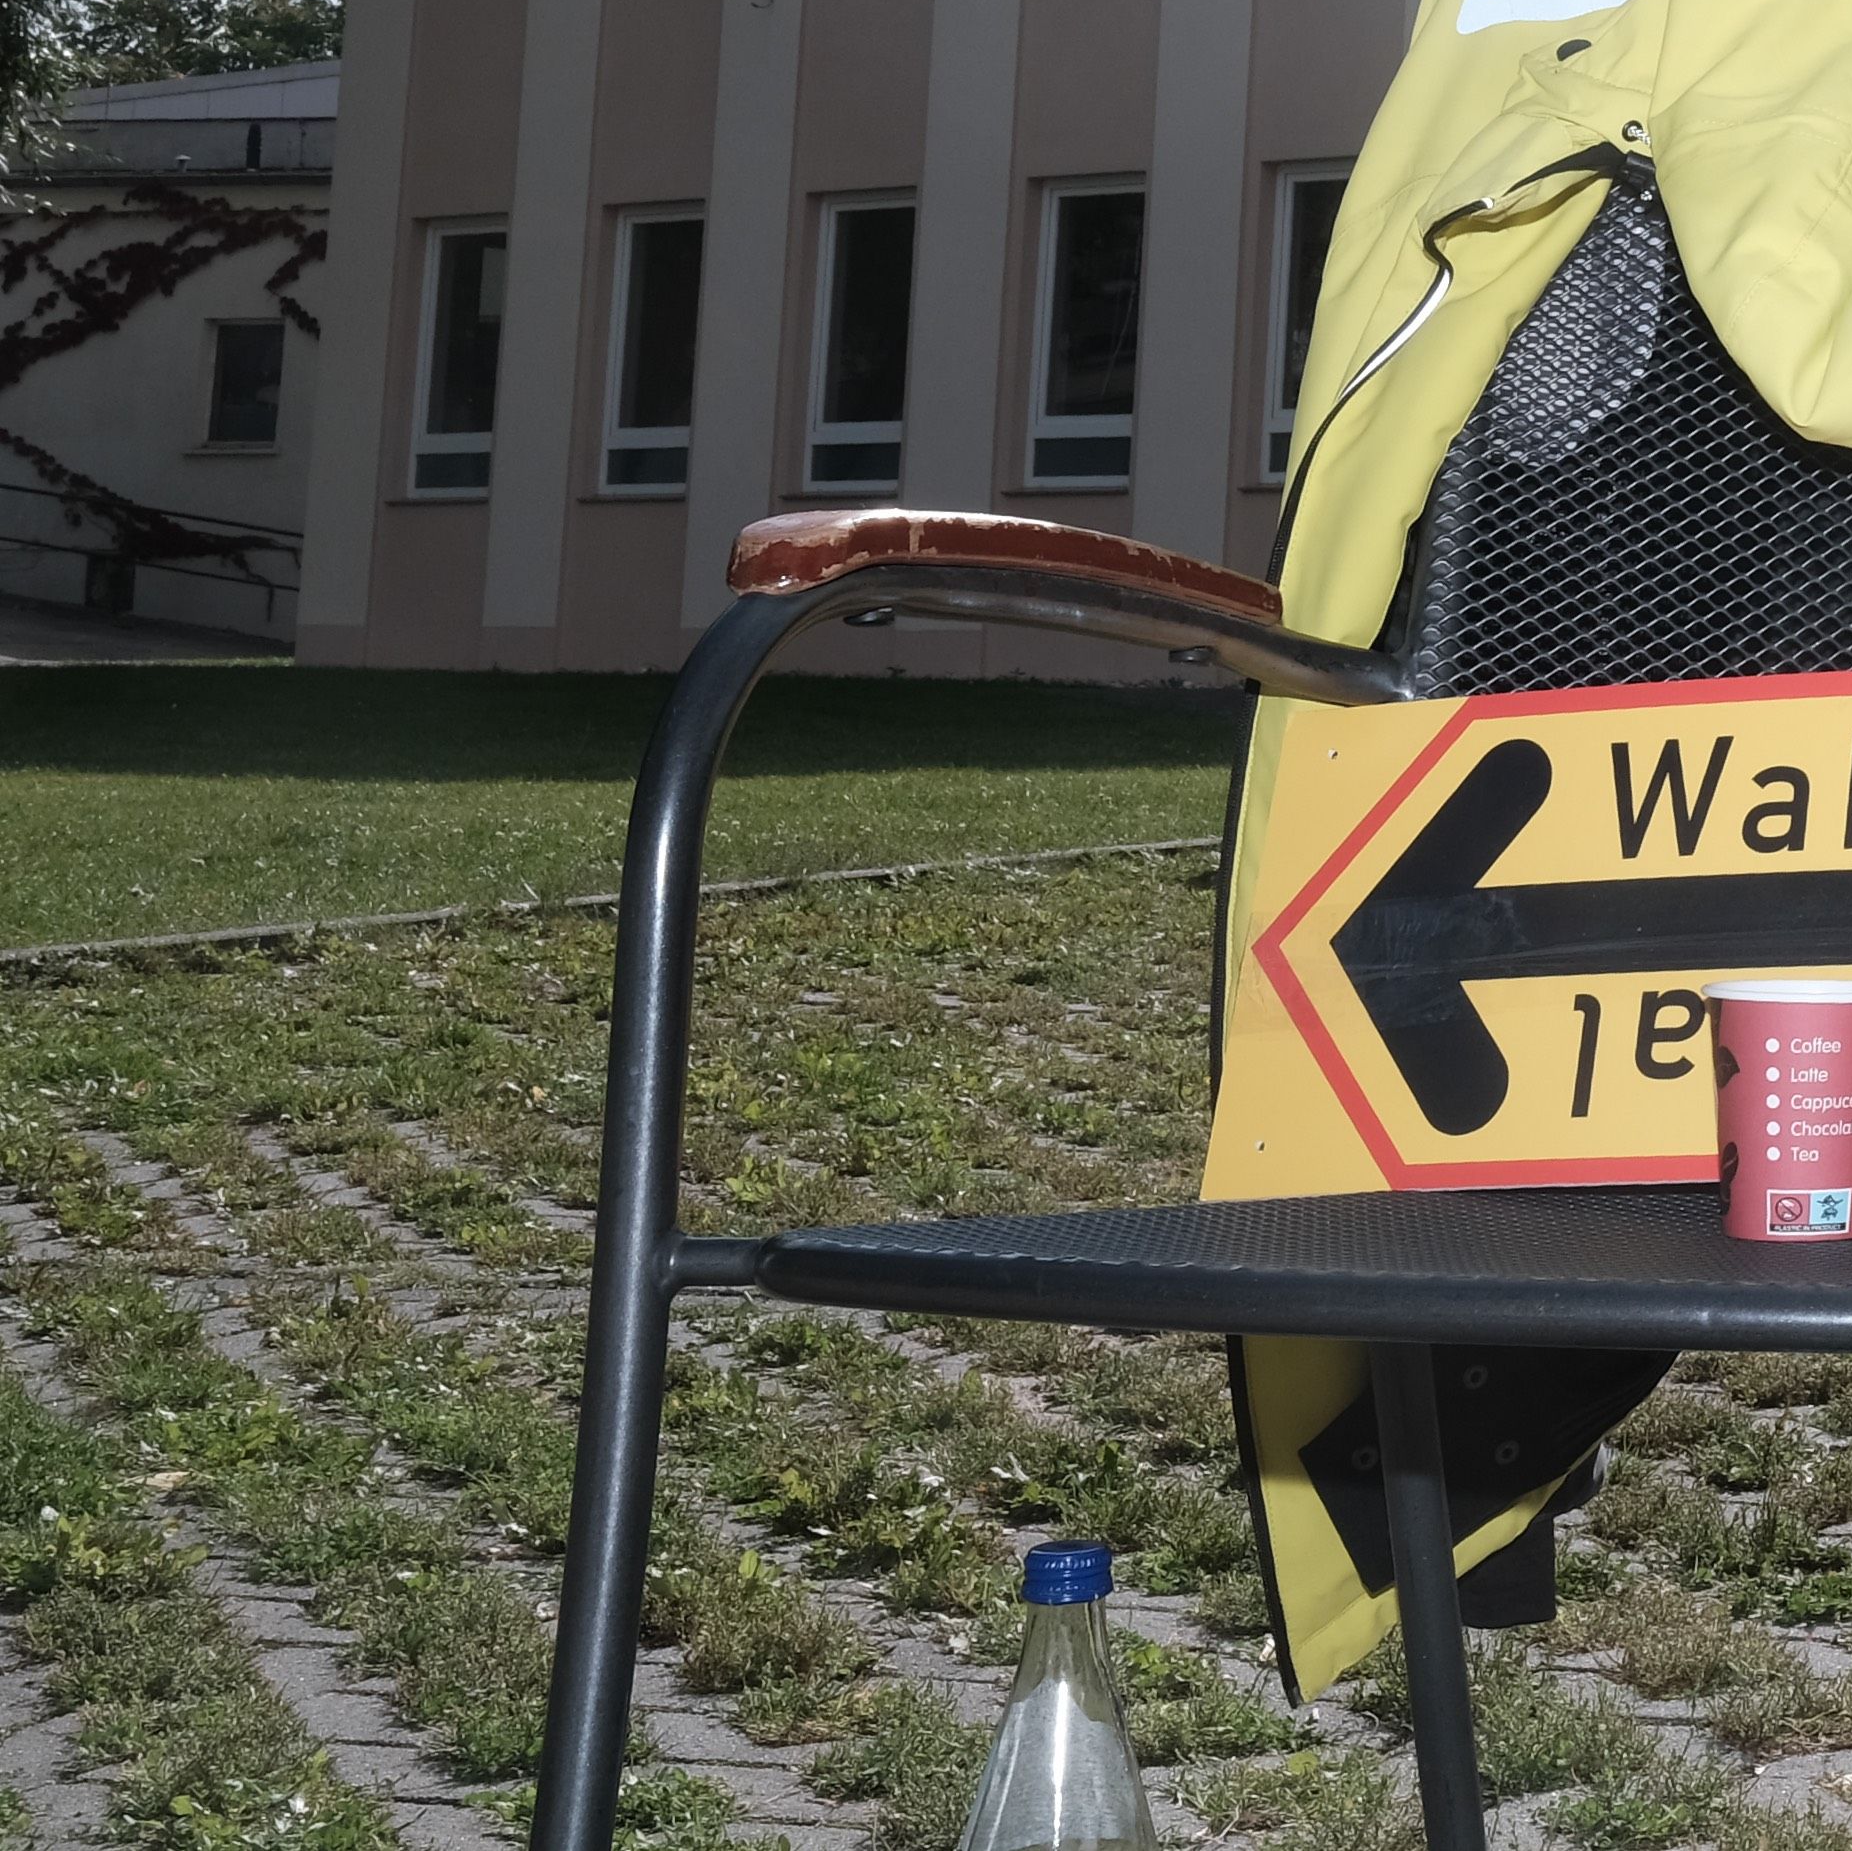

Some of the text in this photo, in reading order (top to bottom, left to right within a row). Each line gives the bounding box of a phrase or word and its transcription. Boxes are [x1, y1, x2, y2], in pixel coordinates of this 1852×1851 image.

[1790, 1037, 1842, 1054] Coffee
[1790, 1067, 1829, 1083] Latte
[1790, 1146, 1819, 1161] Tea
